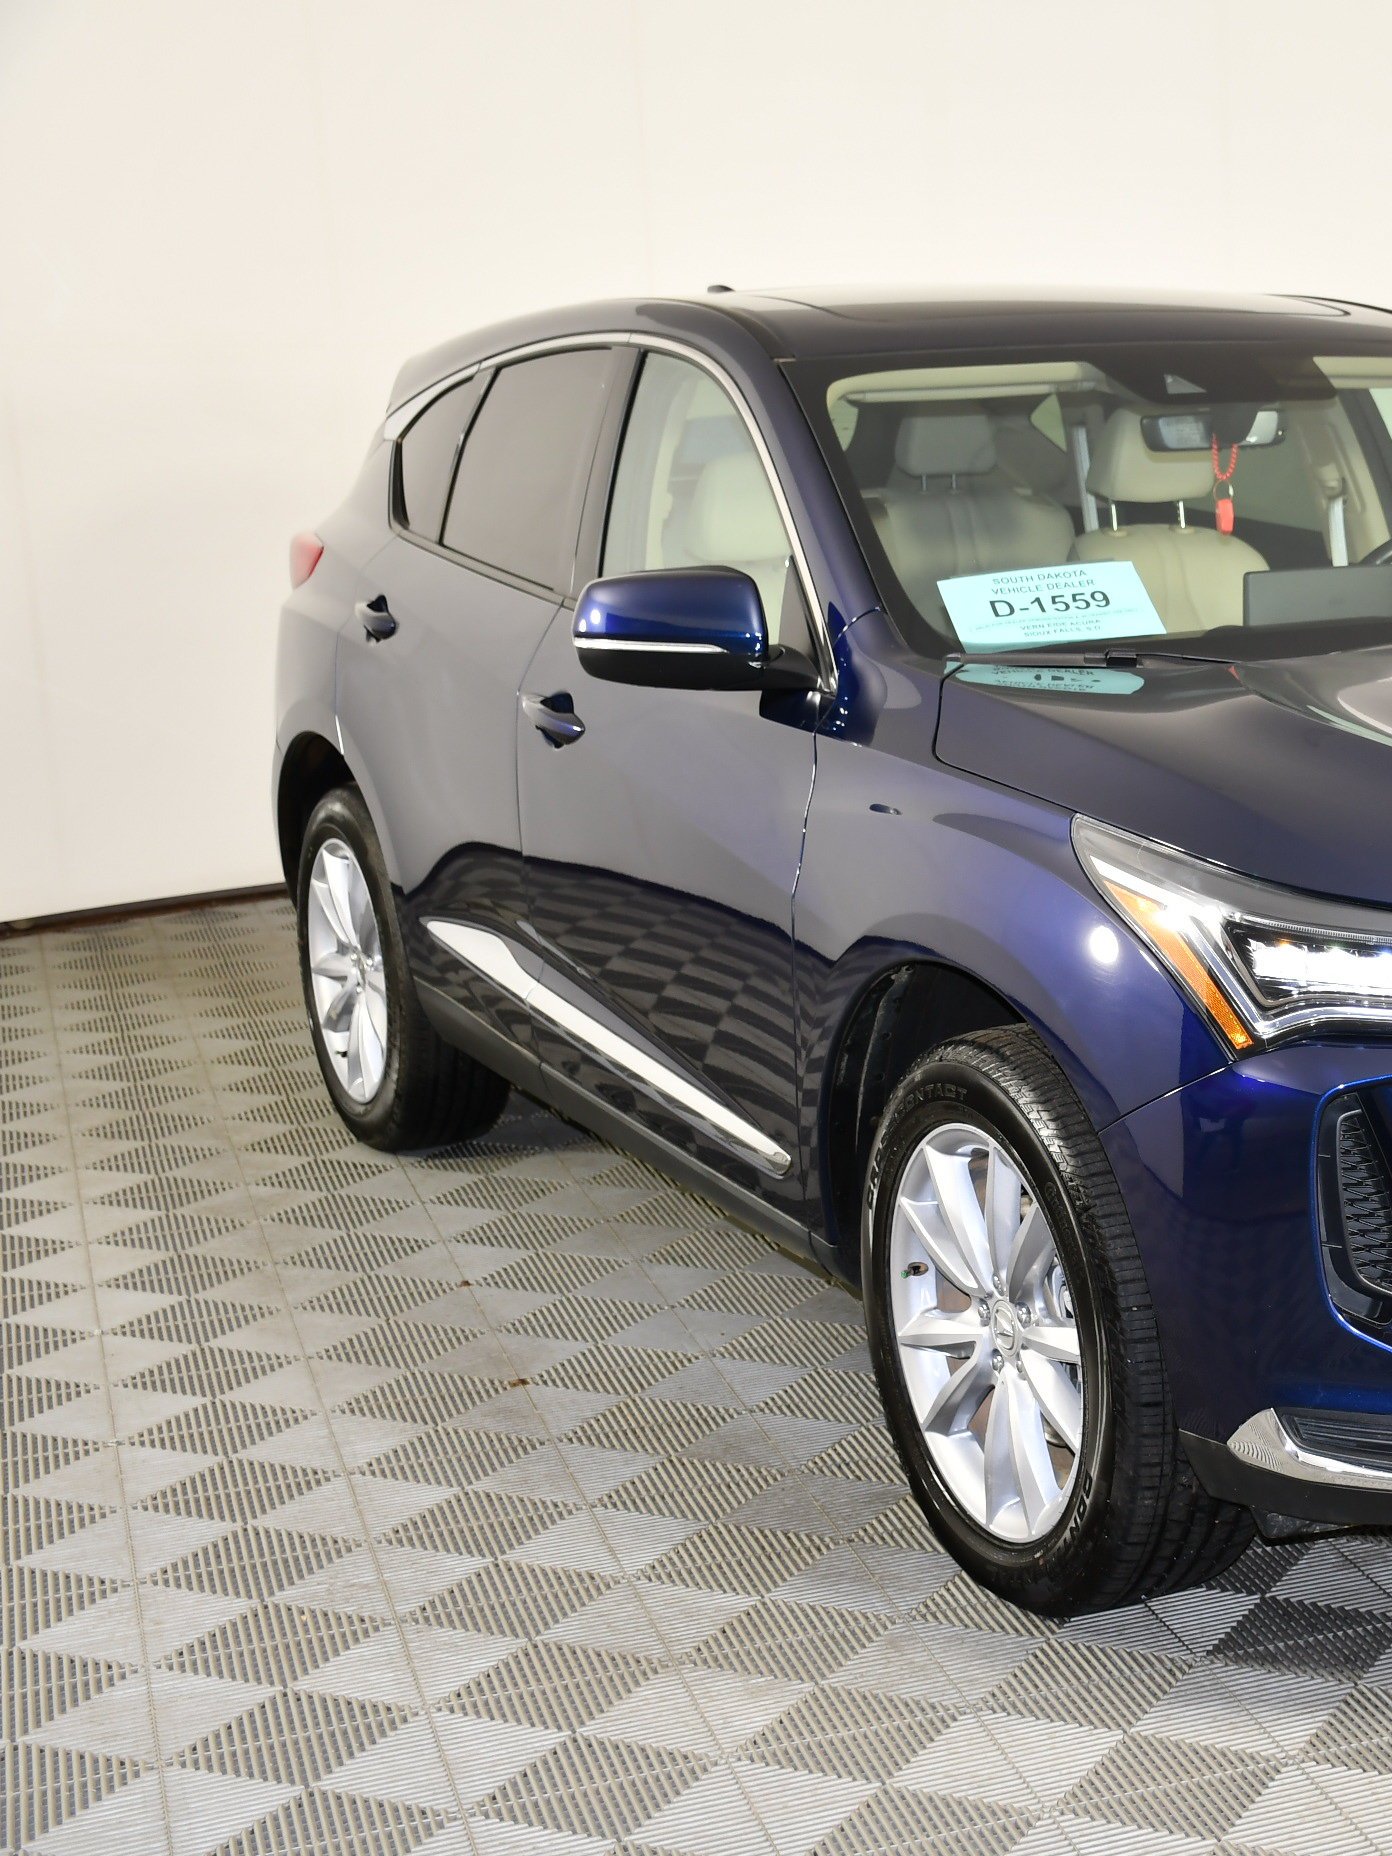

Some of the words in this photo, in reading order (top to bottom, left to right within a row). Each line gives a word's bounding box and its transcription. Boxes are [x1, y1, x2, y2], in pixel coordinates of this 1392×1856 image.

[992, 575, 1034, 585] SOUTH
[1037, 569, 1088, 580] DAKOTA
[991, 585, 1043, 595] VEHICLE
[1046, 578, 1096, 591] DEALER
[988, 590, 1111, 618] D-1559
